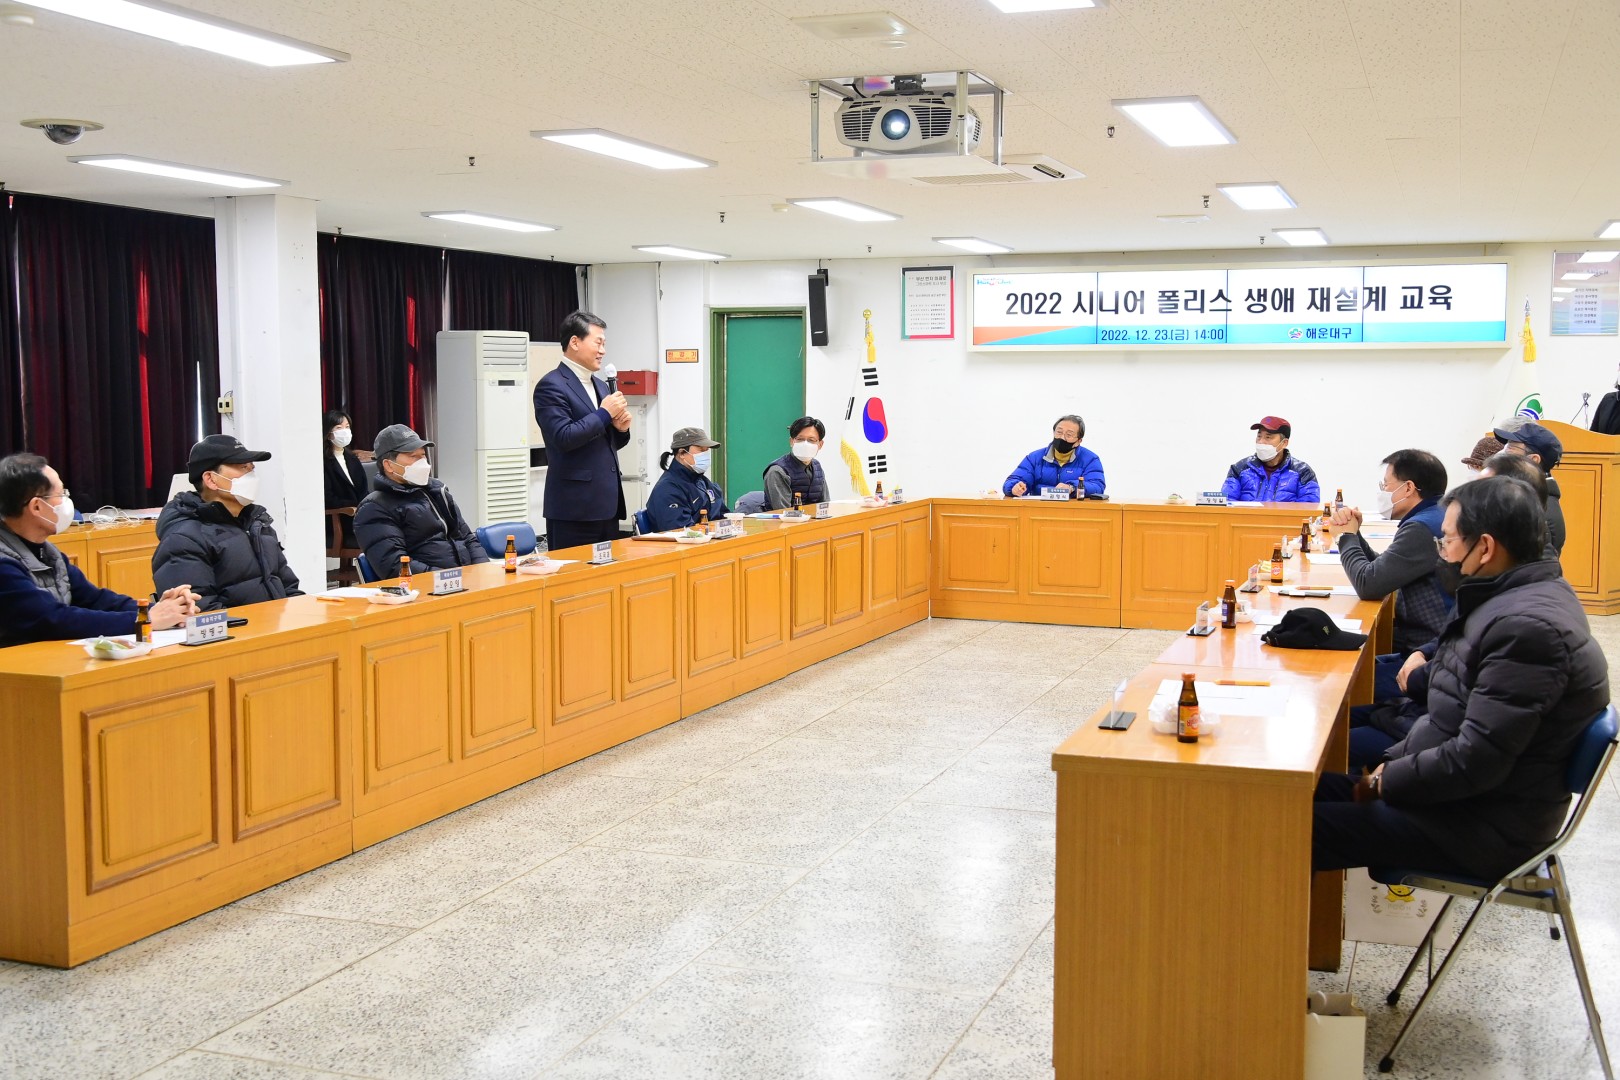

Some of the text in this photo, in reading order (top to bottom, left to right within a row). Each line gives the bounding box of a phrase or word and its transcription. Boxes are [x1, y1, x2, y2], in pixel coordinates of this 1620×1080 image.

[1005, 284, 1453, 315] 2022 시니어 폴리스 생애 재설계 교육
[1101, 328, 1225, 342] 2022. 12. 23.(금) 14:00
[1305, 326, 1352, 340] 해운대구
